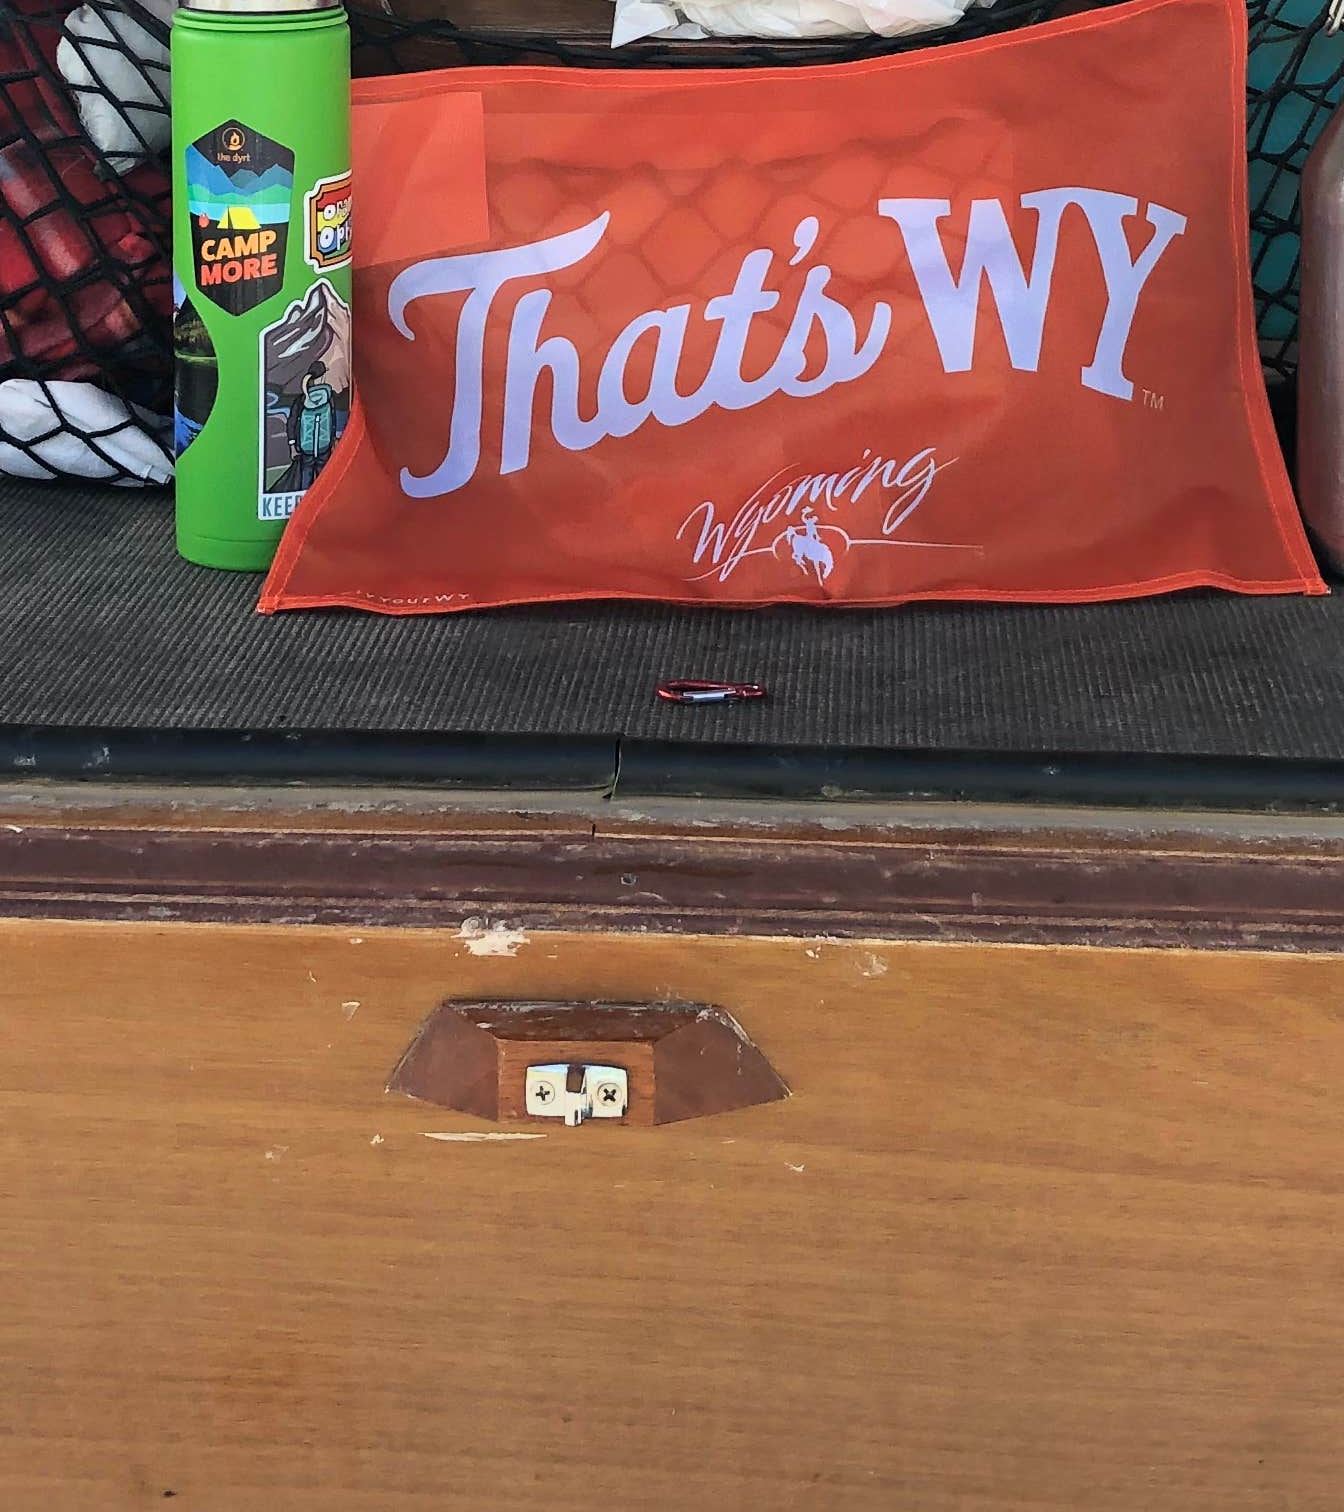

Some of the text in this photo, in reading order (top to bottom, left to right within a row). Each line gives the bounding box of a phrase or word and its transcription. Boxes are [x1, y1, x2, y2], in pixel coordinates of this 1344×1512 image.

[201, 230, 277, 262] CAMP
[201, 253, 278, 286] MORE
[388, 208, 893, 499] That's
[878, 186, 1188, 402] WY
[675, 447, 960, 582] Wyoming
